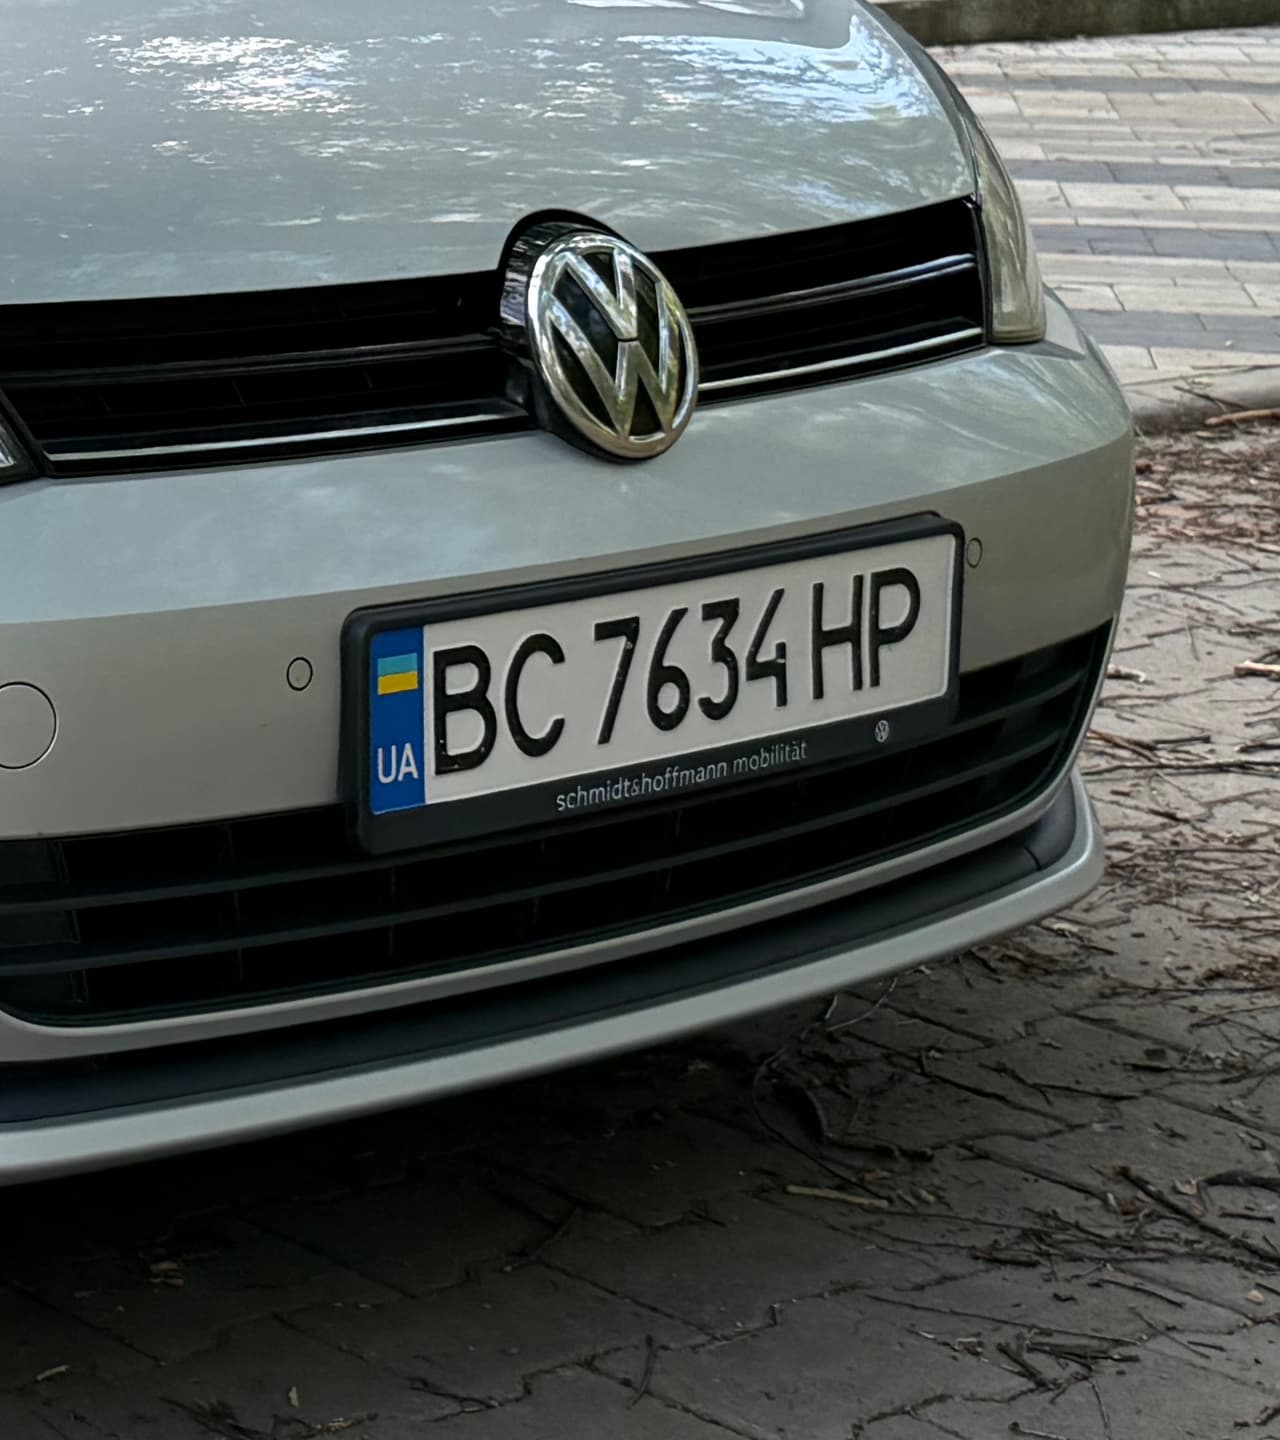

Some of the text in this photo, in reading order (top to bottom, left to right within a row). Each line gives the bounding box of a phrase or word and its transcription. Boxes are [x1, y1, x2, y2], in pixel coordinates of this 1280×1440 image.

[433, 567, 921, 775] BC 7634 HP
[377, 741, 419, 785] UA
[555, 739, 808, 812] schmidt&hoffmann mobilität
